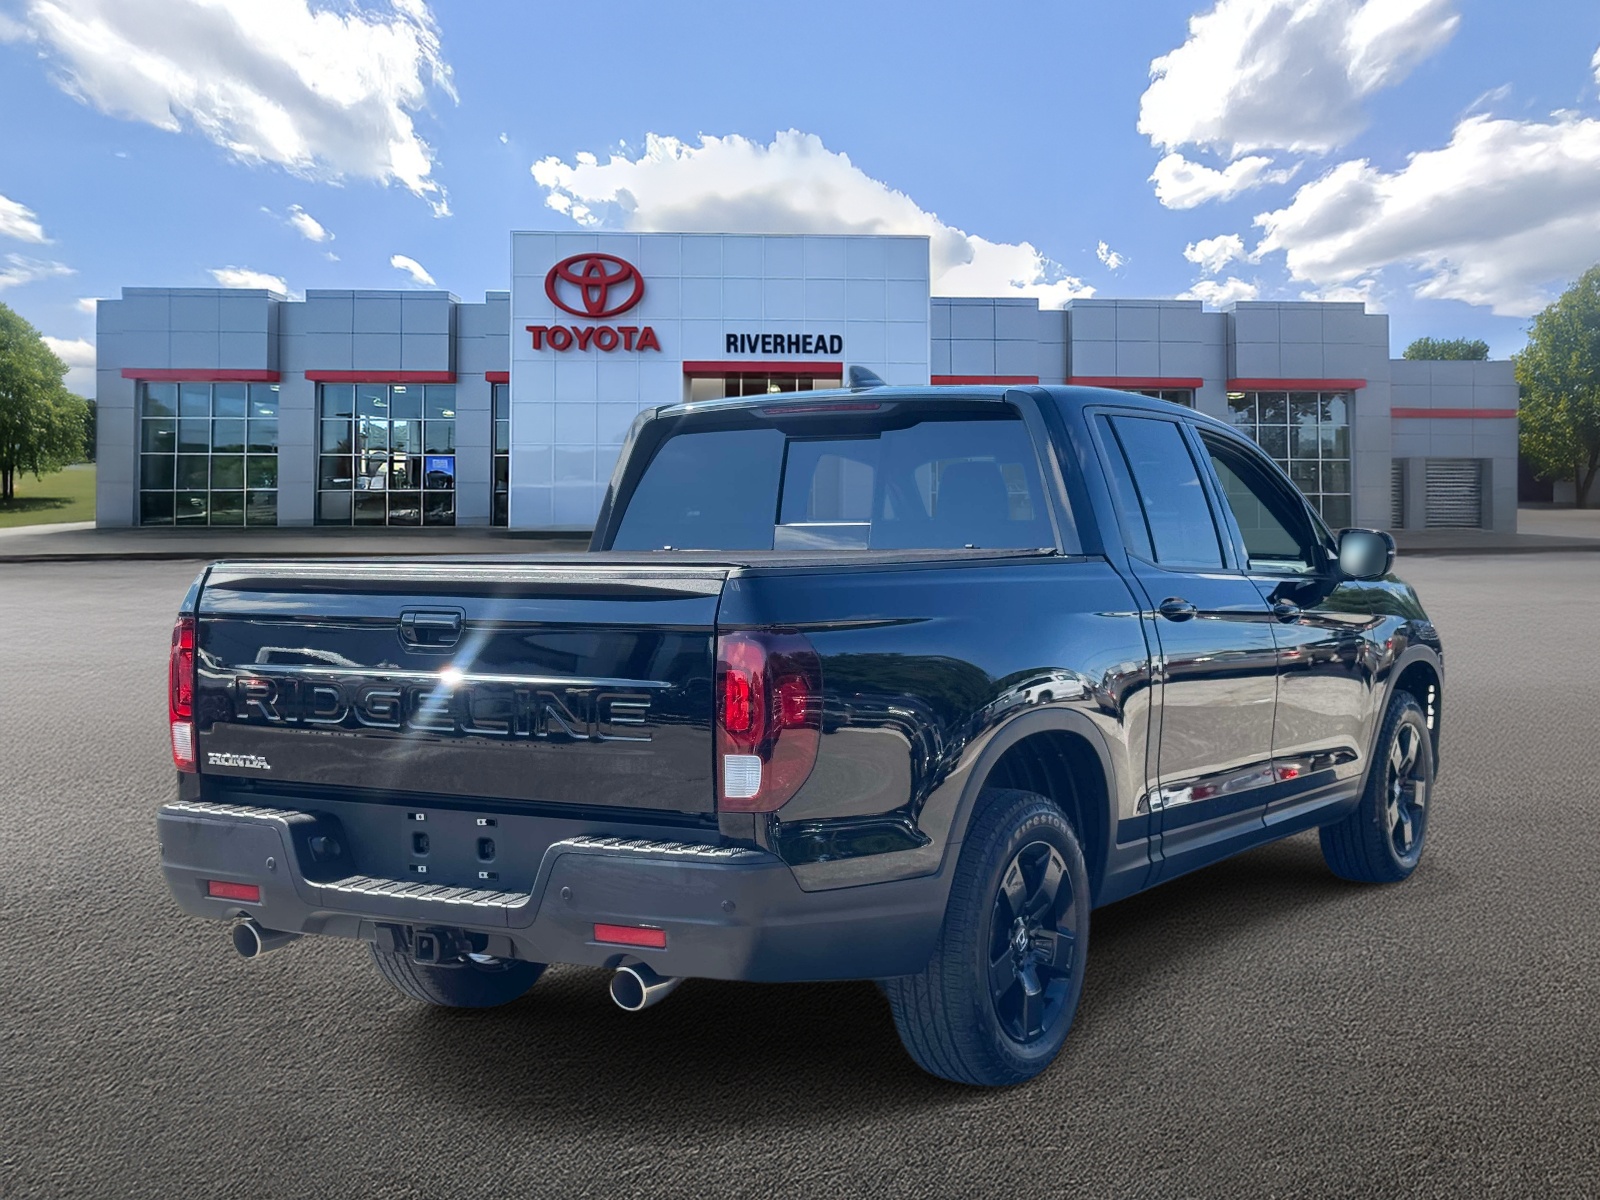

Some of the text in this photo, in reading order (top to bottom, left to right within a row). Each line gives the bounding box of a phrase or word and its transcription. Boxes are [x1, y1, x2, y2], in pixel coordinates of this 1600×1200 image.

[525, 325, 661, 352] TOYOTA
[726, 333, 843, 354] RIVERHEAD
[236, 676, 652, 742] RIDGELINE
[207, 752, 271, 769] HONDA
